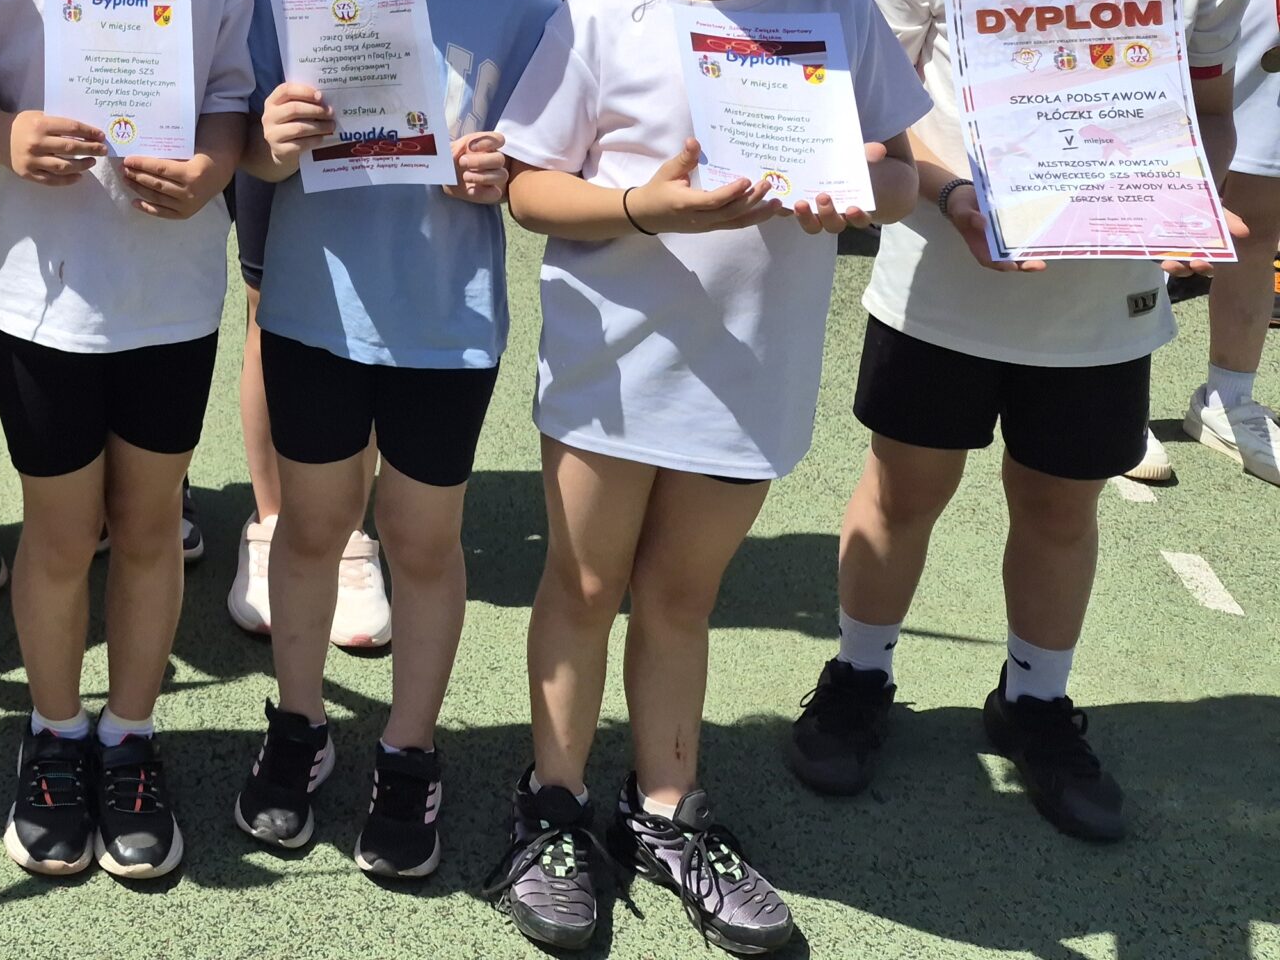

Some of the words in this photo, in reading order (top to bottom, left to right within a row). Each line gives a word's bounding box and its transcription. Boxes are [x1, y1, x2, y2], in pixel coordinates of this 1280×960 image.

[976, 0, 1163, 35] DYPLOM
[108, 23, 142, 32] miejsce
[313, 45, 342, 53] Drugich
[362, 42, 391, 50] Zawody
[85, 55, 130, 63] Mistrzostwa
[132, 57, 159, 65] Powiatu
[726, 50, 790, 67] Dyplom
[1130, 55, 1148, 63] SZS
[90, 66, 136, 76] Lwóweckiego
[341, 63, 389, 72] Lwóweckiego
[77, 76, 110, 85] Trójboju
[111, 77, 176, 87] Lekkoatletycznym
[319, 76, 347, 84] Powiatu
[349, 73, 397, 82] Mistrzostwa
[741, 78, 747, 87] V
[751, 80, 788, 90] miejsce
[85, 87, 113, 96] Zawody
[133, 89, 160, 98] Drugich
[94, 99, 127, 107] Igrzyska
[1010, 94, 1062, 106] SZKOŁA
[1066, 90, 1167, 103] PODSTAWOWA
[343, 106, 377, 116] miejsce
[379, 107, 385, 115] V
[724, 107, 775, 120] Mistrzostwa
[778, 114, 810, 122] Powiatu
[1037, 110, 1093, 121] PŁÓCZKI
[1098, 107, 1144, 120] GÓRNE
[731, 118, 783, 132] Lwóweckiego
[787, 125, 805, 133] SZS
[340, 126, 398, 143] Dyplom
[719, 126, 754, 138] Trójboju
[756, 132, 833, 144] Lekkoatletycznym
[1064, 135, 1074, 146] V
[1084, 137, 1114, 146] miejsce
[729, 137, 759, 149] Zawody
[762, 143, 779, 152] Klas
[782, 144, 815, 155] Drugich
[741, 149, 776, 162] Igrzyska
[780, 155, 806, 164] Dzieci
[1037, 159, 1116, 168] MISTRZOSTWA
[1119, 159, 1169, 167] POWIATU
[1029, 170, 1106, 180] LWÓWECKIEGO
[1110, 171, 1130, 179] SZS
[1134, 170, 1181, 179] TRÓJBÓJ
[1010, 184, 1106, 192] LEKKOATLETYCZNY
[1118, 183, 1163, 191] ZAWODY
[1069, 195, 1114, 203] IGRZYSK
[1118, 194, 1155, 202] DZIECI
